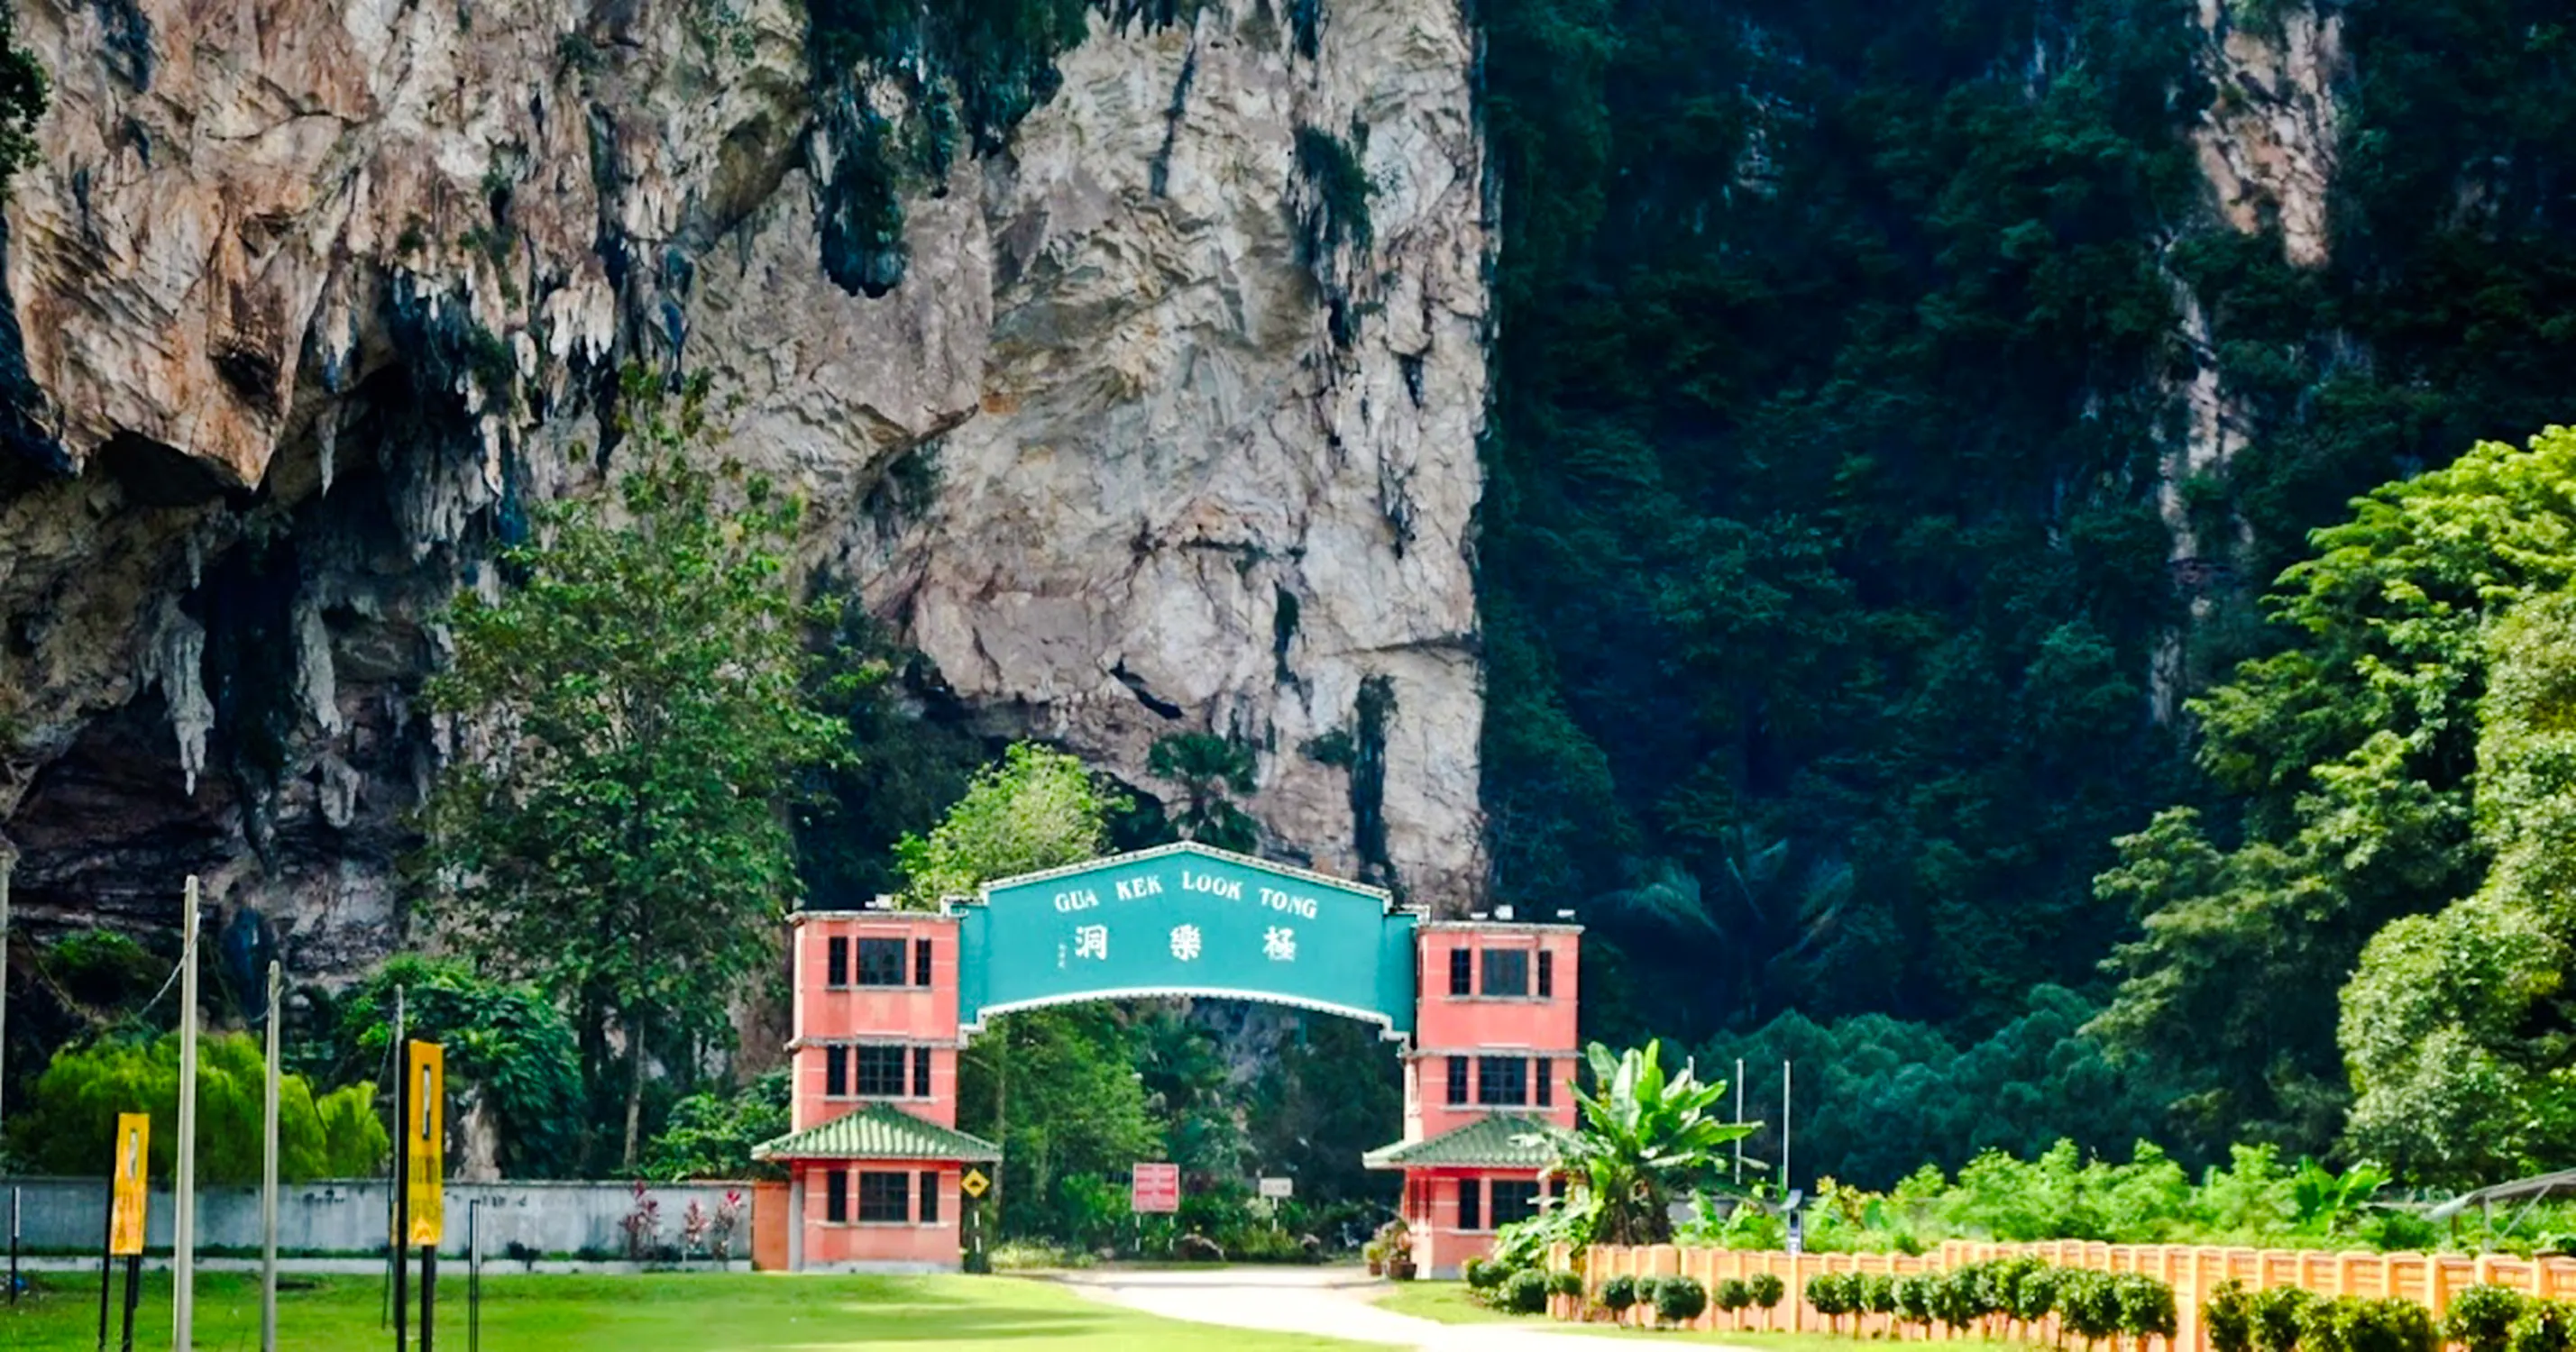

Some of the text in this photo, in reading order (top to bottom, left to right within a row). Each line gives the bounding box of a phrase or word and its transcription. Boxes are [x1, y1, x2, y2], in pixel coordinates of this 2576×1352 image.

[1055, 871, 1317, 919] GUA KEK LOOK TONG
